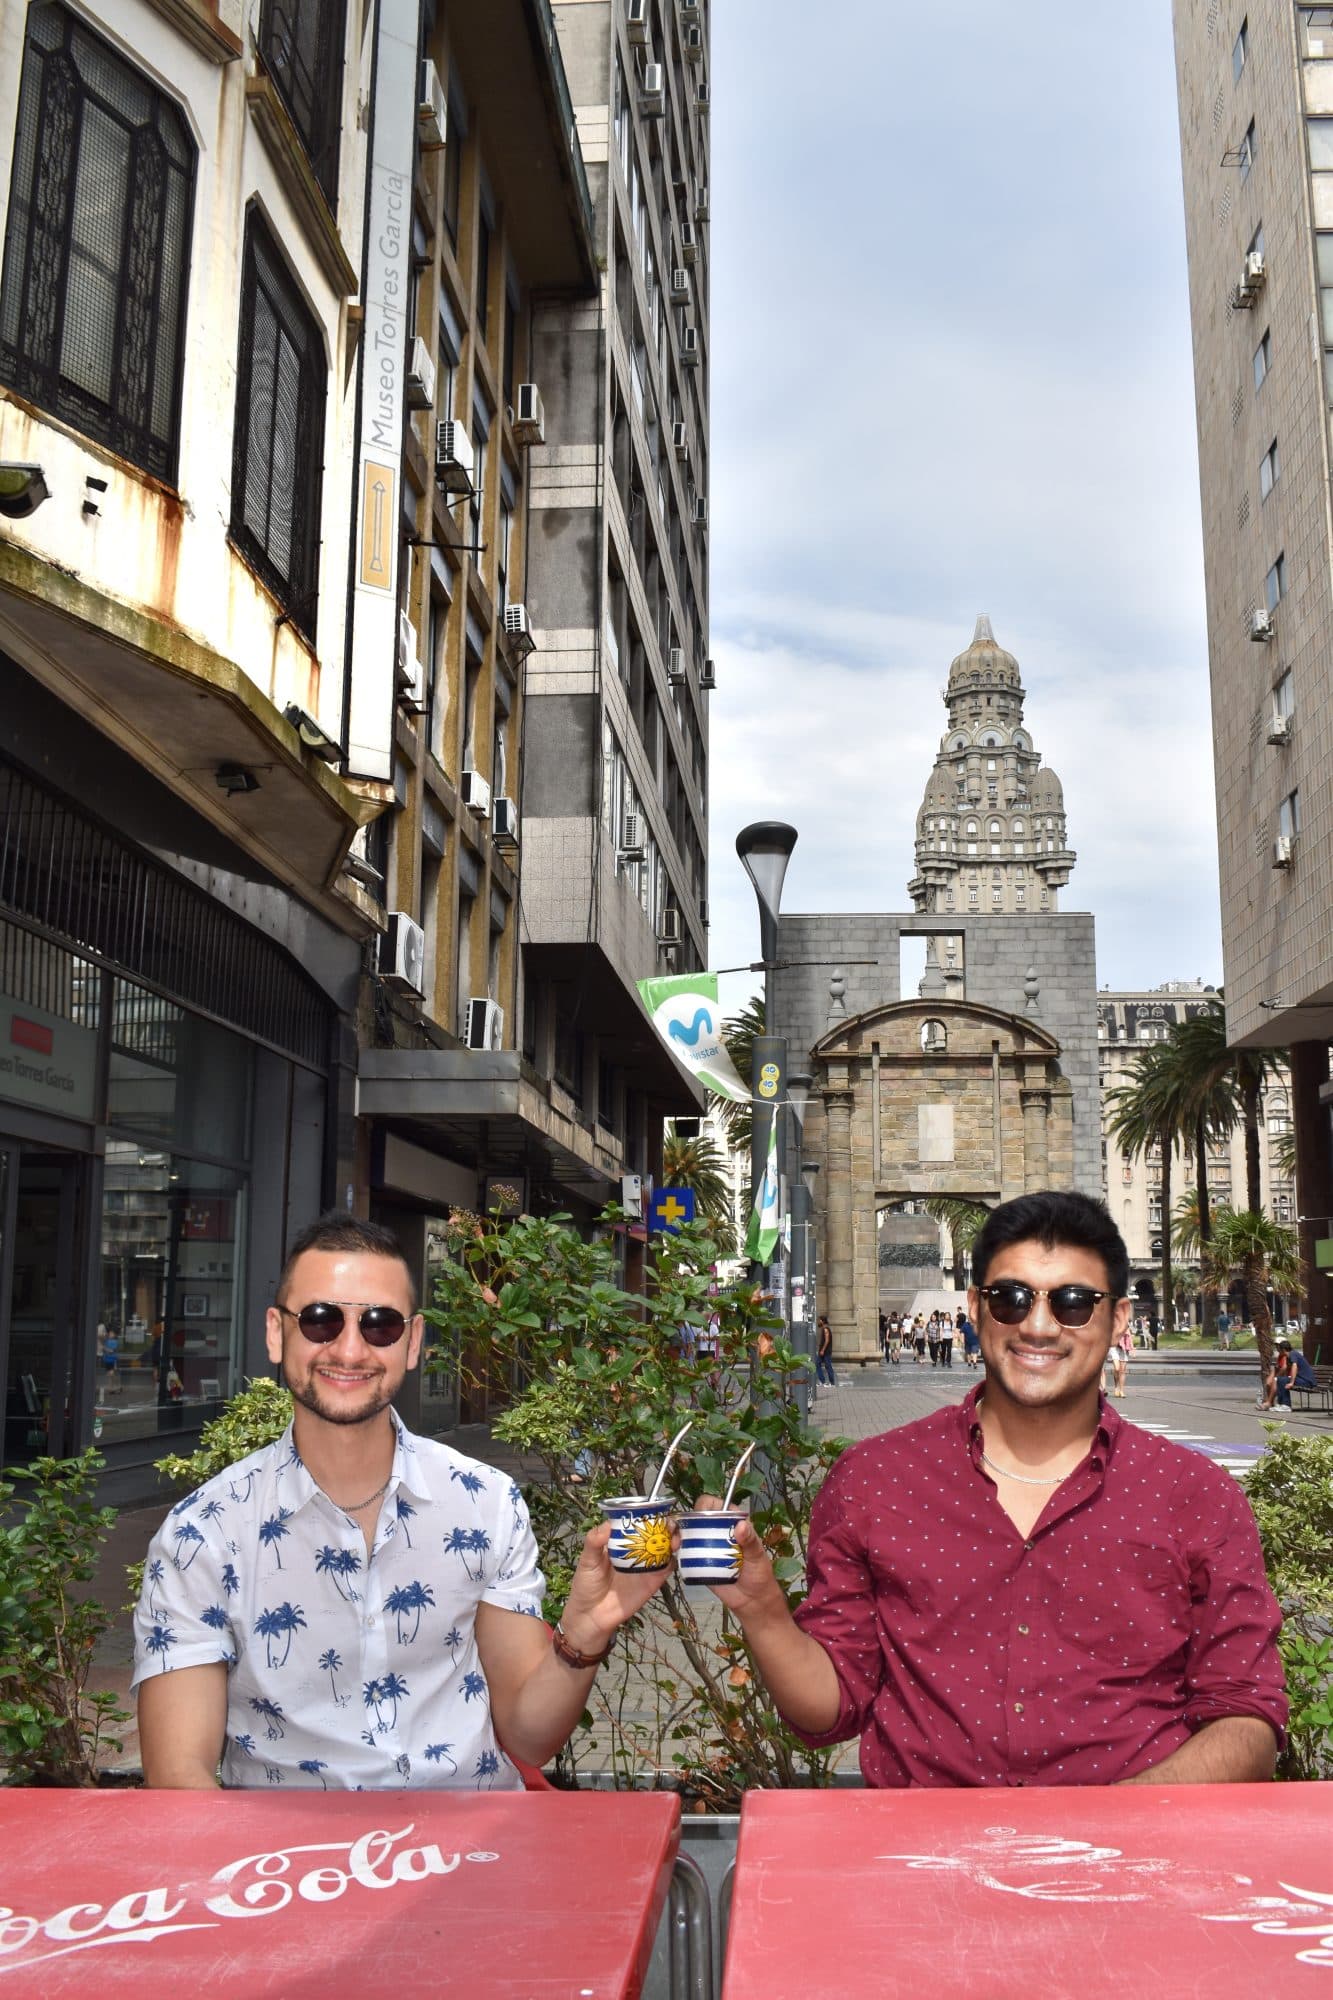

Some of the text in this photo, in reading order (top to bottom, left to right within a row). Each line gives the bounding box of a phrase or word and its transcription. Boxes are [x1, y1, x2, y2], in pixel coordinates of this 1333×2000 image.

[371, 172, 403, 448] Museo Torres García
[14, 1055, 43, 1082] Torres
[0, 1822, 461, 1955] oca Cola
